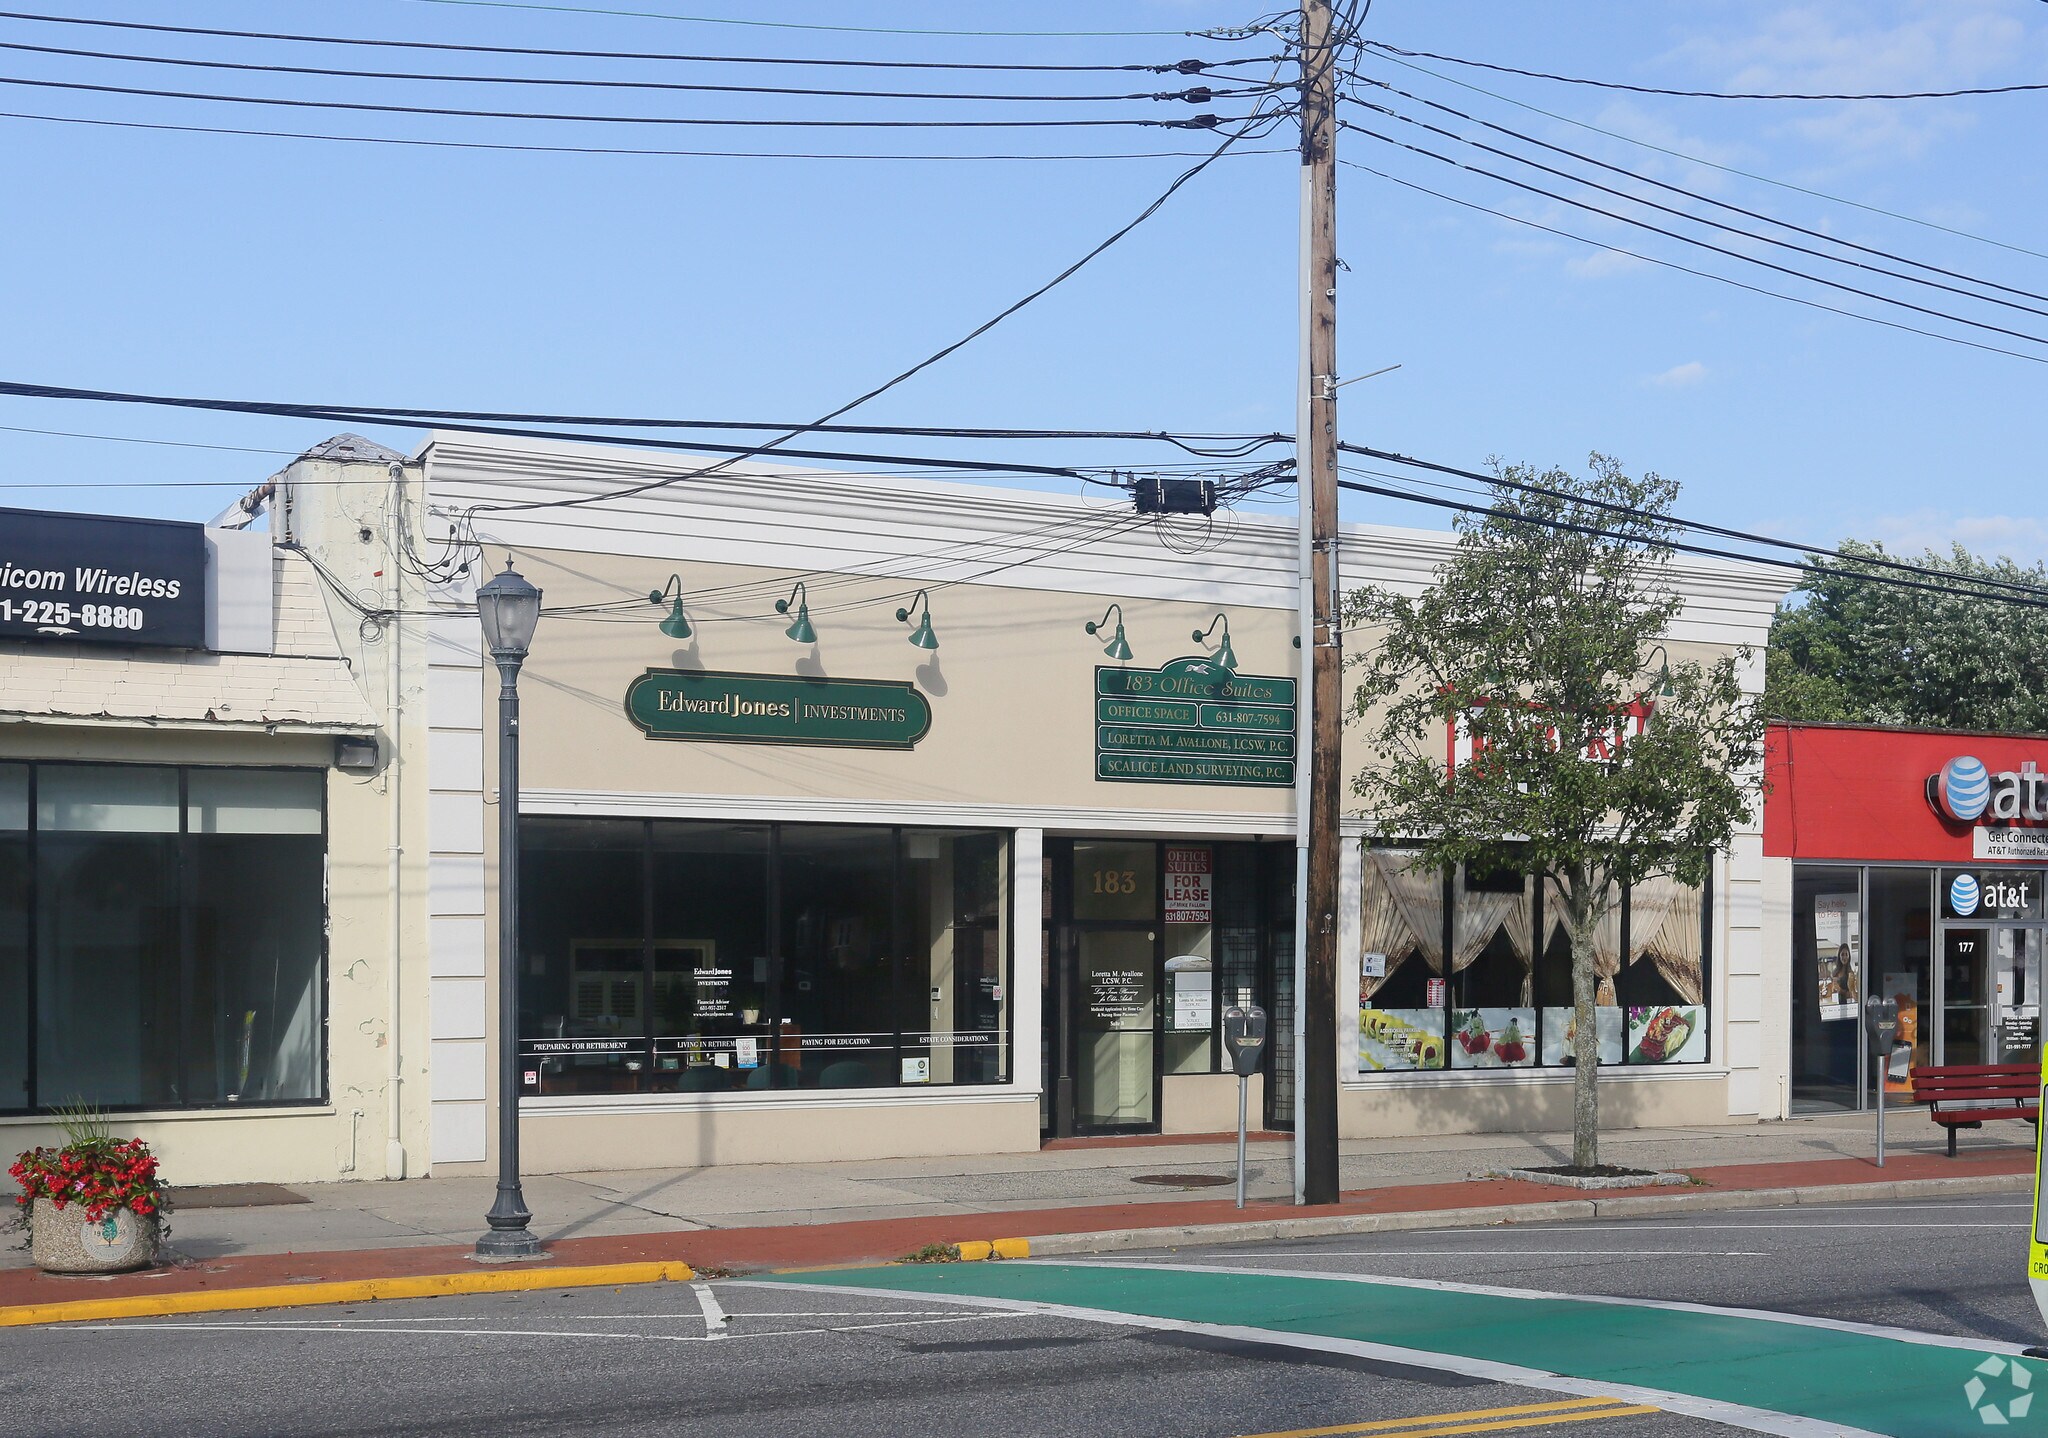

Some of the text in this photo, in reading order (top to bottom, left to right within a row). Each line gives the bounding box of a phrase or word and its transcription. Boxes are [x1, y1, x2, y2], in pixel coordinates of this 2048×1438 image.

[0, 562, 181, 599] icom Wireless
[1160, 676, 1215, 696] Office
[1221, 681, 1272, 699] Suites
[804, 704, 906, 722] INVESTMENTS
[1108, 705, 1190, 720] OFFICE SPACE
[1215, 711, 1281, 725] 631-807-7594
[1107, 733, 1288, 752] LORETTA M. AVALLONE, LCSW, P.C.
[1108, 760, 1285, 778] SCALICE LAND SURVEYING, P.C.
[1988, 831, 2005, 843] Get
[1168, 851, 1207, 861] OFFICE
[1988, 846, 2006, 855] AT&T
[2007, 847, 2036, 856] Authorized
[1168, 862, 1207, 872] SUITES
[1093, 870, 1136, 894] 183
[1174, 875, 1201, 887] FOR
[1166, 889, 1209, 901] LEASE
[1984, 882, 2029, 908] at&t
[1958, 942, 1974, 953] 177
[940, 1035, 989, 1043] CONSIDERATIONS
